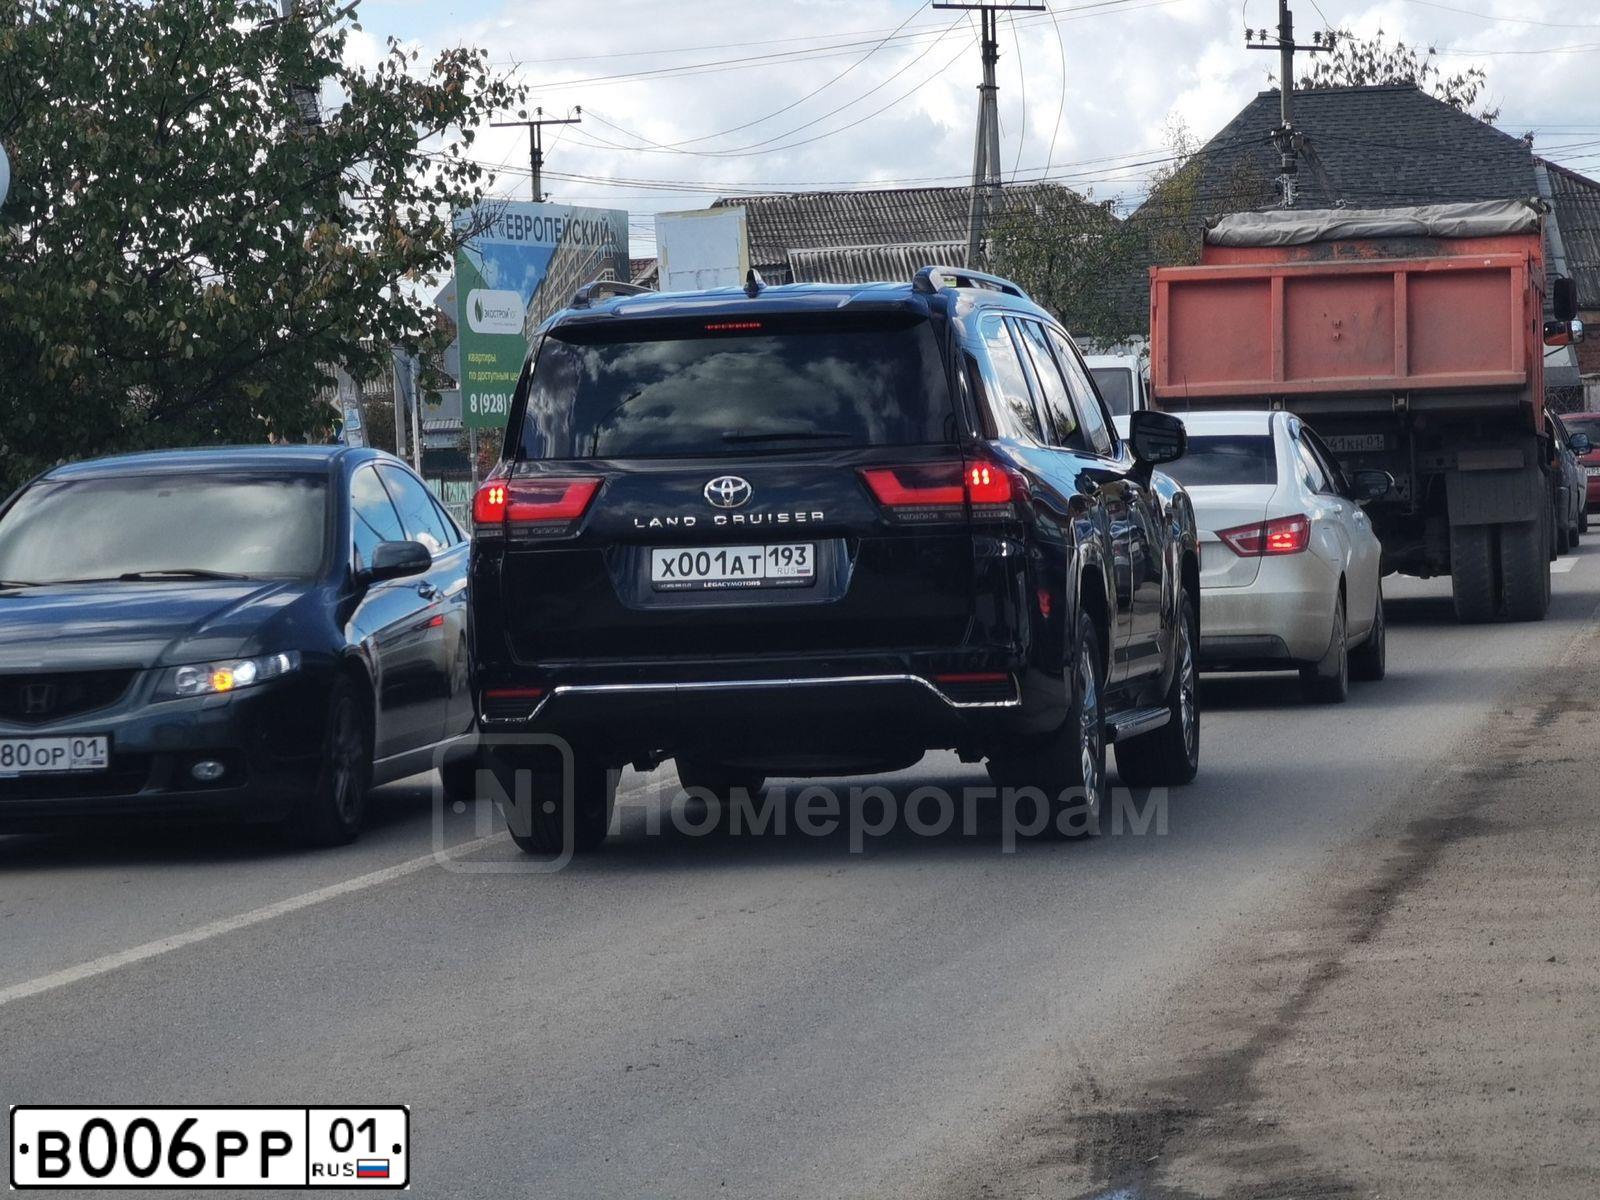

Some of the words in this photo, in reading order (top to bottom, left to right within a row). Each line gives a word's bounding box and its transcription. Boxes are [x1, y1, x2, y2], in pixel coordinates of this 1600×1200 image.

[499, 212, 616, 246] «ЕВРОПЕЙСКИЙ»
[468, 352, 496, 364] квартиры
[468, 371, 477, 381] по
[470, 393, 477, 413] 8
[480, 392, 507, 416] (928)
[634, 515, 697, 528] LAND
[713, 511, 825, 526] CRUISER
[660, 550, 762, 578] Х001АТ
[767, 546, 807, 567] 193
[776, 567, 796, 575] RUS
[703, 579, 762, 588] LEGACYMOTORS
[73, 739, 98, 758] 01
